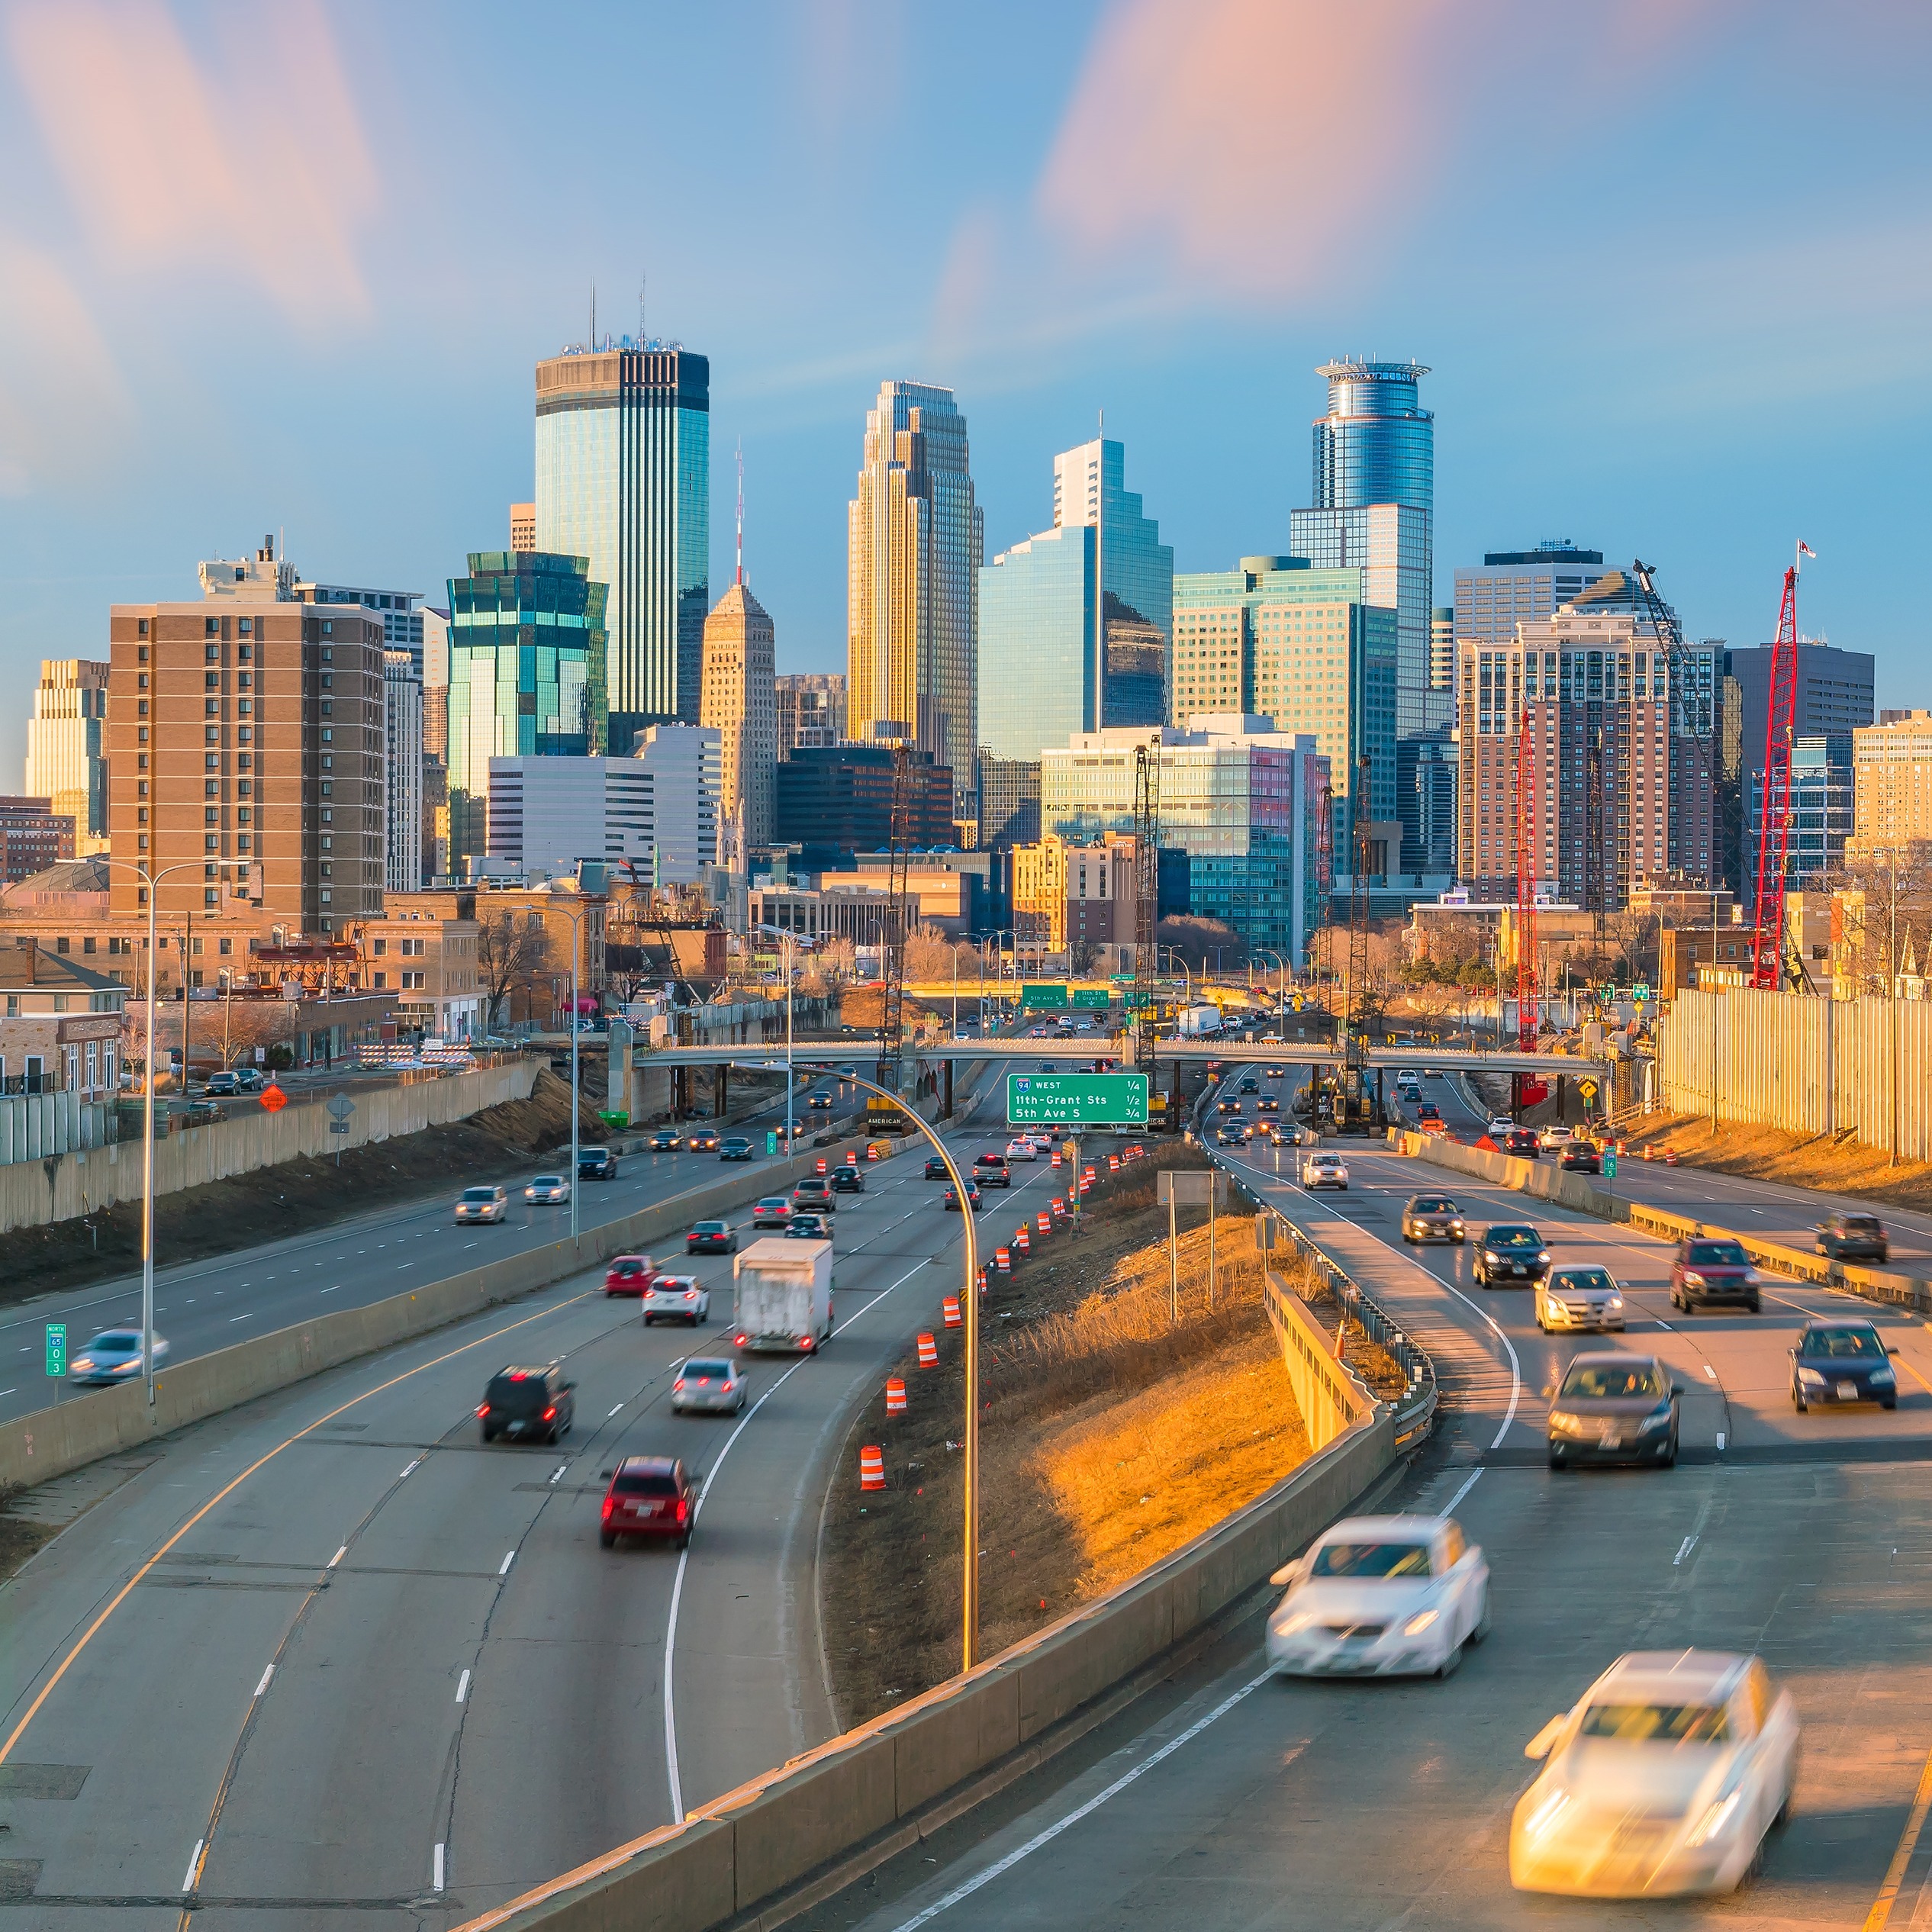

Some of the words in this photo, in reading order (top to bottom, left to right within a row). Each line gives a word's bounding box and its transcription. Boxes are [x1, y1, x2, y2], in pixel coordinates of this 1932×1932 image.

[1018, 1081, 1029, 1090] 94
[1035, 1081, 1061, 1090] WEST
[1016, 1095, 1080, 1105] 11th-Grant
[1087, 1095, 1107, 1105] Sts
[1016, 1109, 1037, 1118] 5th
[1044, 1109, 1067, 1118] Ave
[1073, 1109, 1080, 1118] S
[53, 1348, 60, 1359] 0
